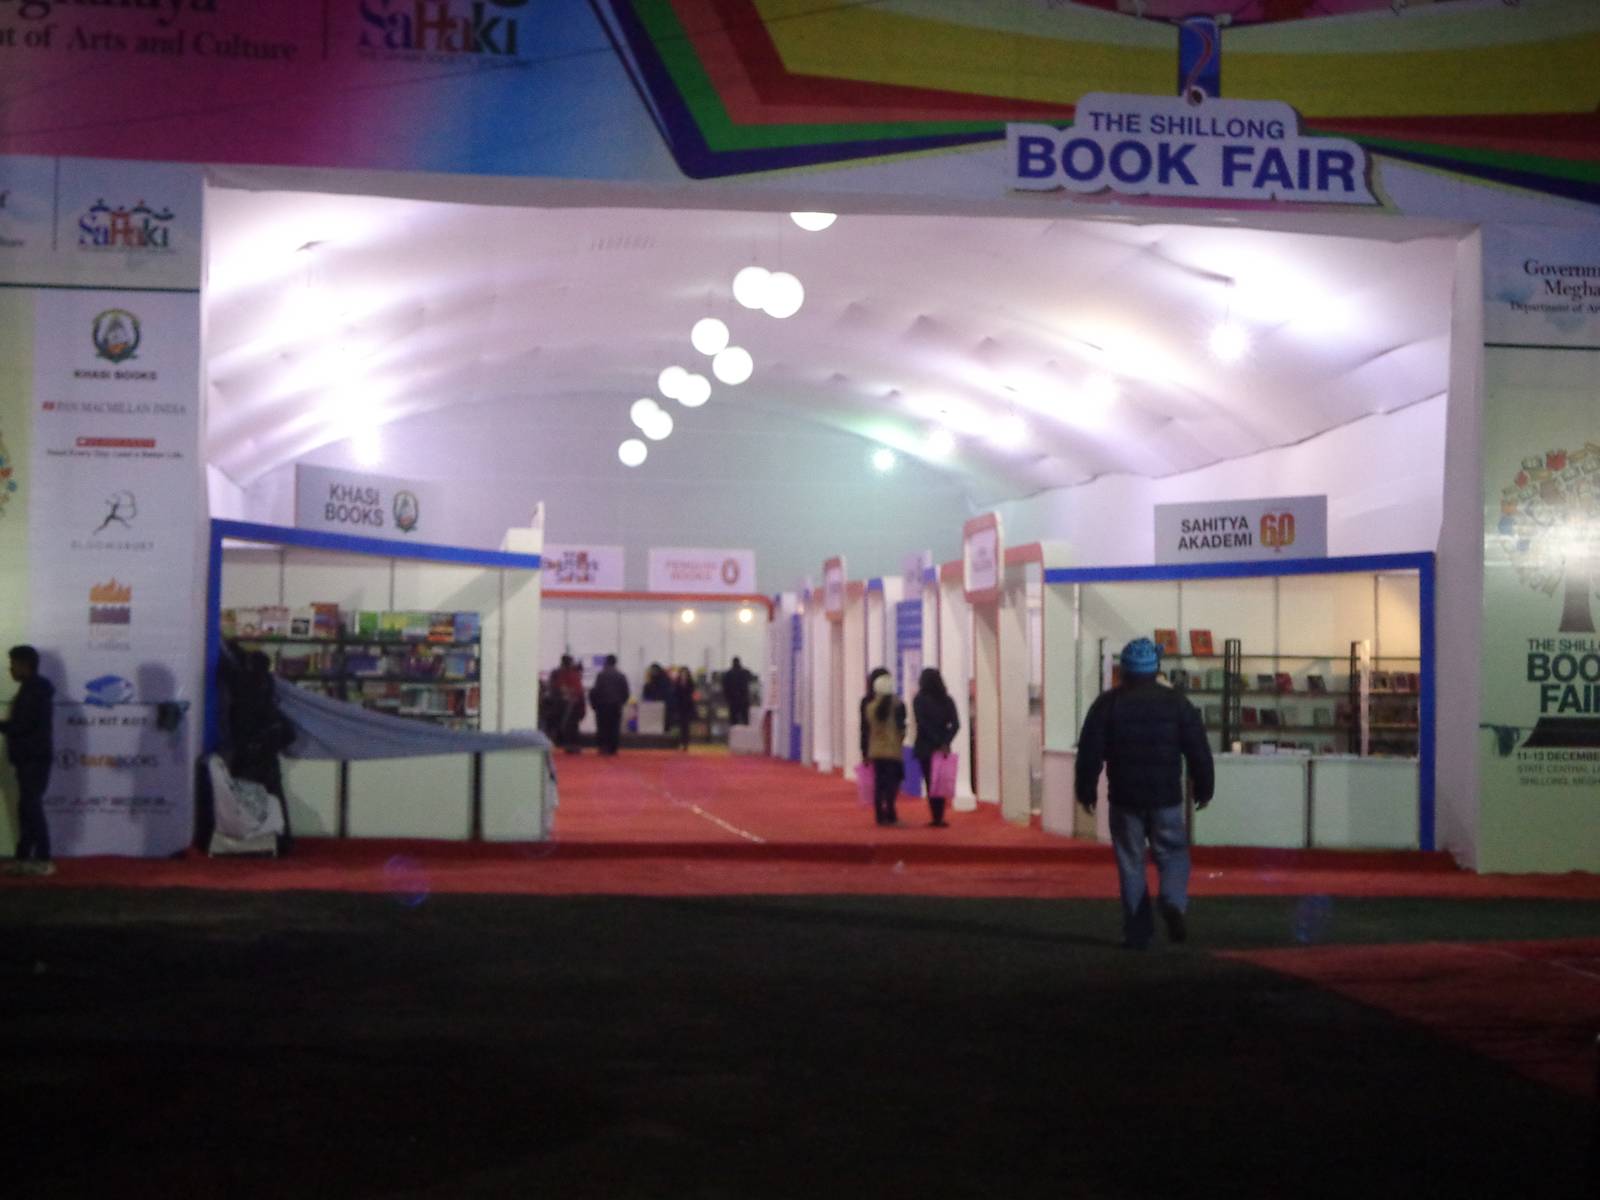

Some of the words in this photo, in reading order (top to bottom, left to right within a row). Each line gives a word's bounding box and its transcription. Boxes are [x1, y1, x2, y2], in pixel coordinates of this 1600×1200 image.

[24, 23, 57, 48] of
[66, 25, 127, 51] Arts
[134, 29, 185, 56] and
[192, 30, 299, 61] Culture
[1089, 111, 1141, 134] THE
[1150, 114, 1285, 140] SHILLONG
[1017, 135, 1198, 186] BOOK
[1221, 144, 1356, 192] FAIR
[329, 483, 380, 504] KHASI
[324, 502, 384, 527] BOOKS
[1181, 516, 1249, 534] SAHITYA
[1178, 533, 1253, 550] AKADEMI
[1528, 638, 1555, 651] THE
